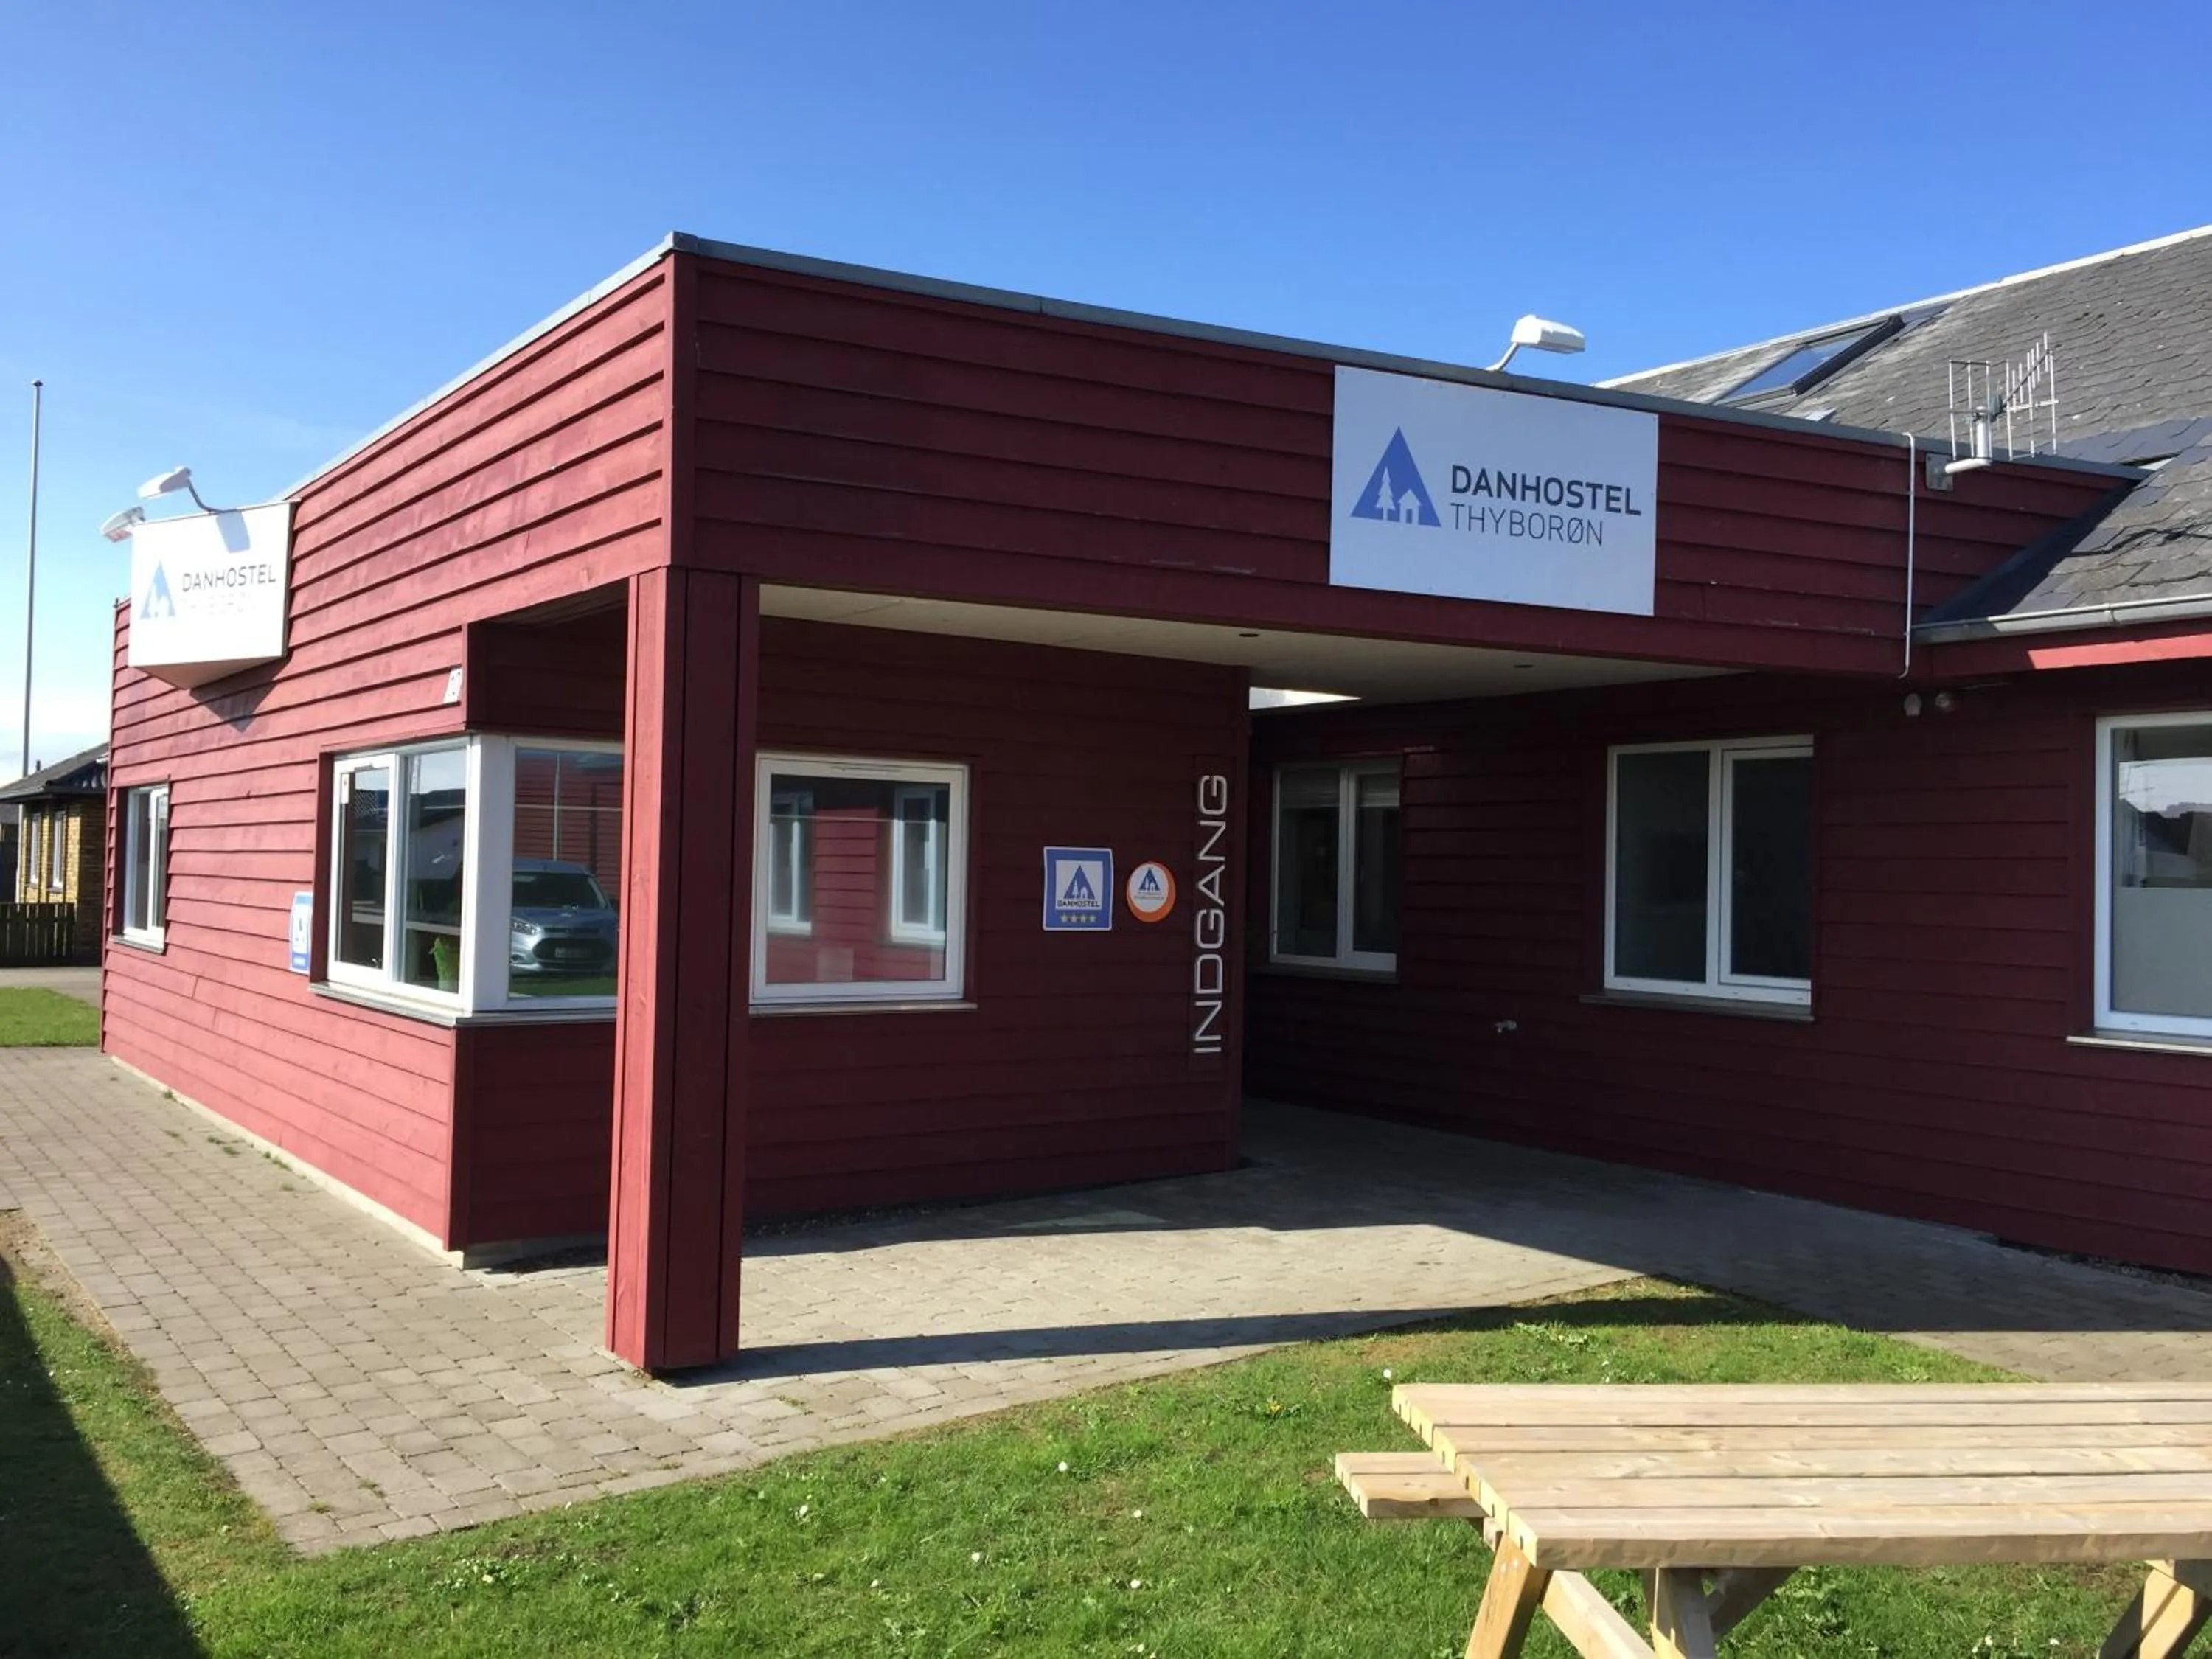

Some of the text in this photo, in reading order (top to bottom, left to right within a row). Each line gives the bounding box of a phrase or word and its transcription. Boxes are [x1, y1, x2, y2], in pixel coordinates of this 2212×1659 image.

[1450, 465, 1641, 515] DANHOSTEL
[1450, 503, 1603, 546] THYBORØN
[182, 563, 276, 592] DANHOSTEL
[1057, 900, 1101, 908] DANHOSTEL
[1193, 774, 1228, 1054] INDGANG
